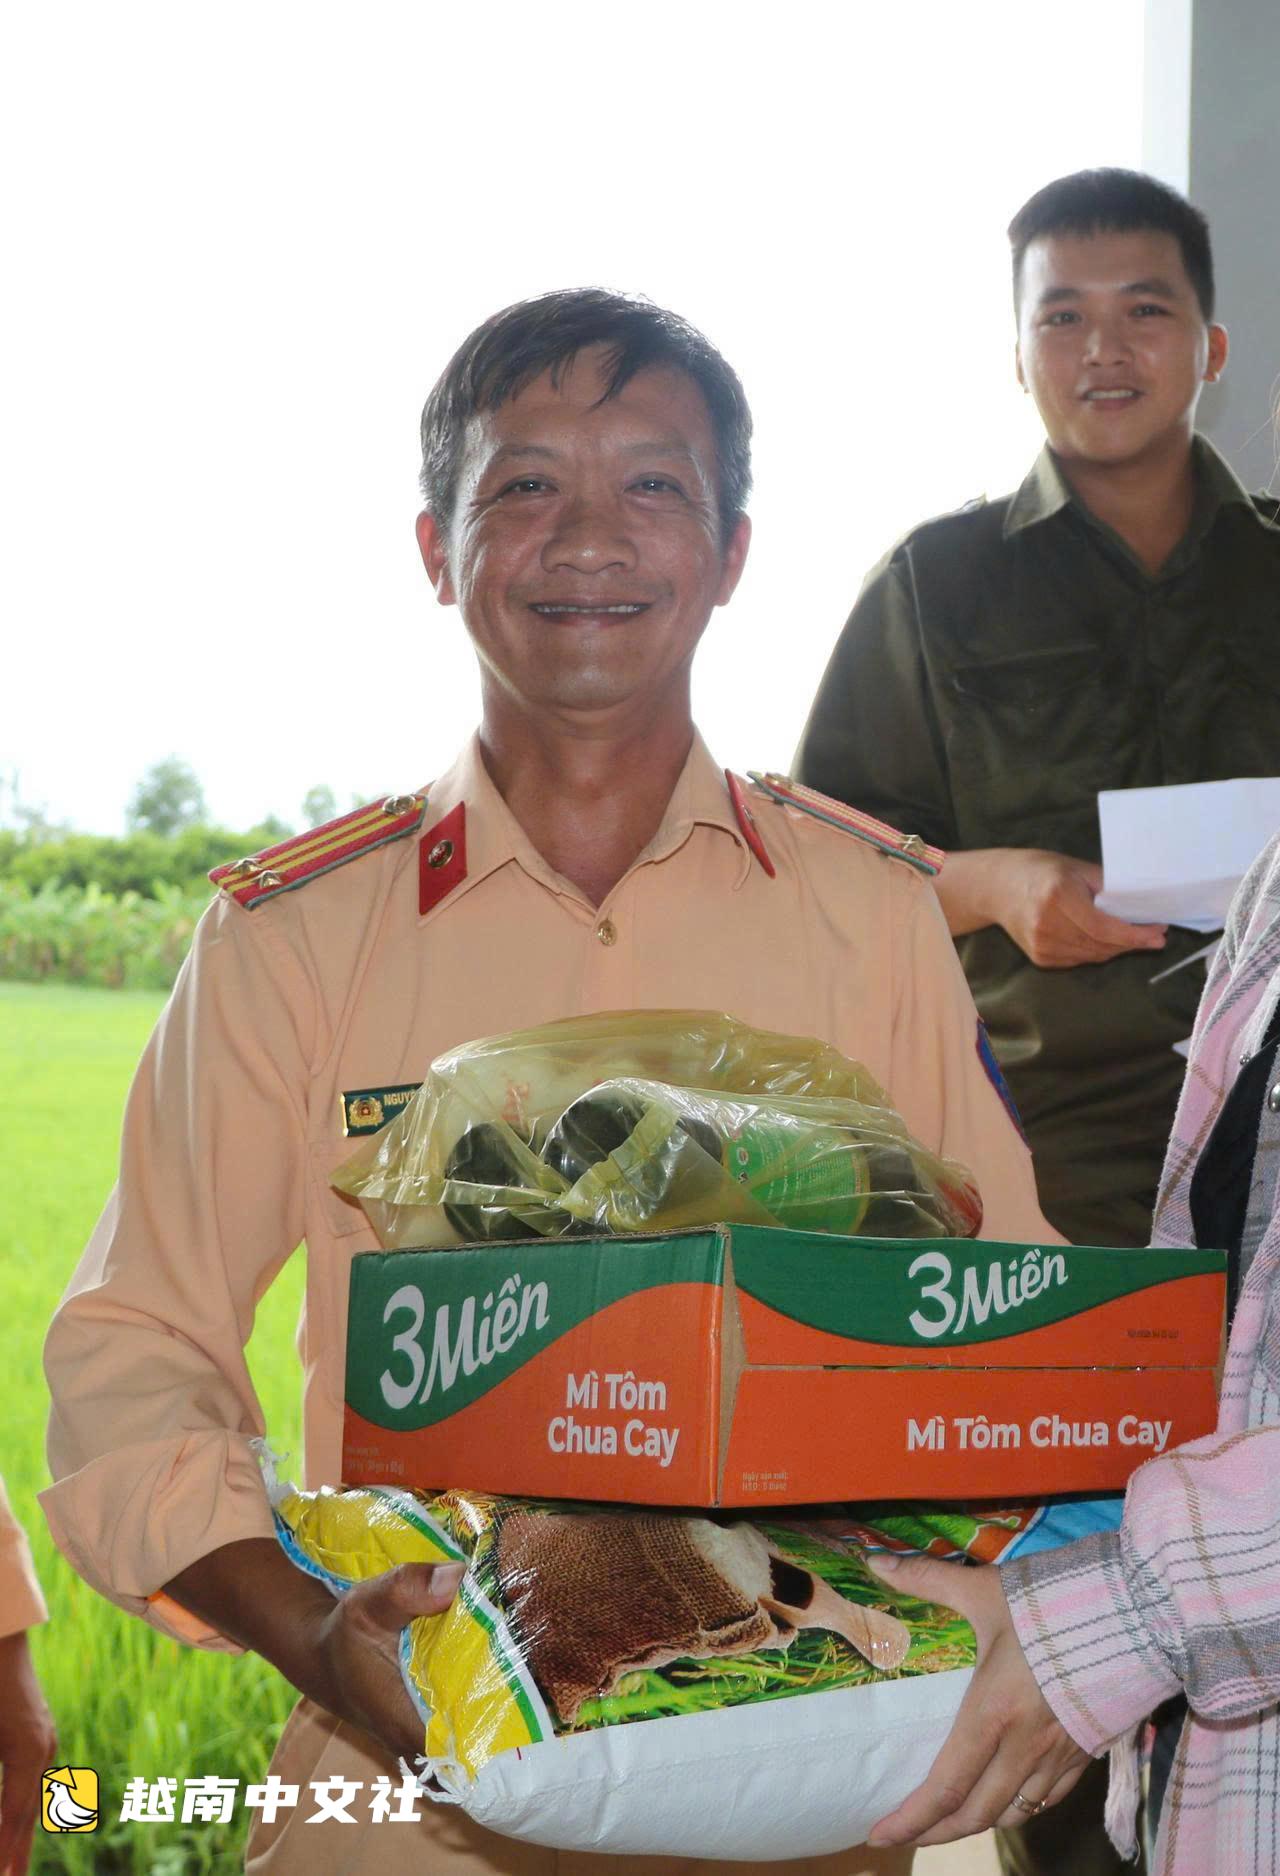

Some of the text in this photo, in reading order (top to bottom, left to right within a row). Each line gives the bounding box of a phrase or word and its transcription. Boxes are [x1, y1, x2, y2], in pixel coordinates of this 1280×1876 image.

[908, 1247, 1069, 1339] 3 Miền
[379, 1272, 550, 1410] 3 Miền
[566, 1370, 668, 1411] Mì Tôm
[547, 1415, 681, 1468] Chua Cay
[907, 1414, 1173, 1452] Mì Tôm Chua Cay
